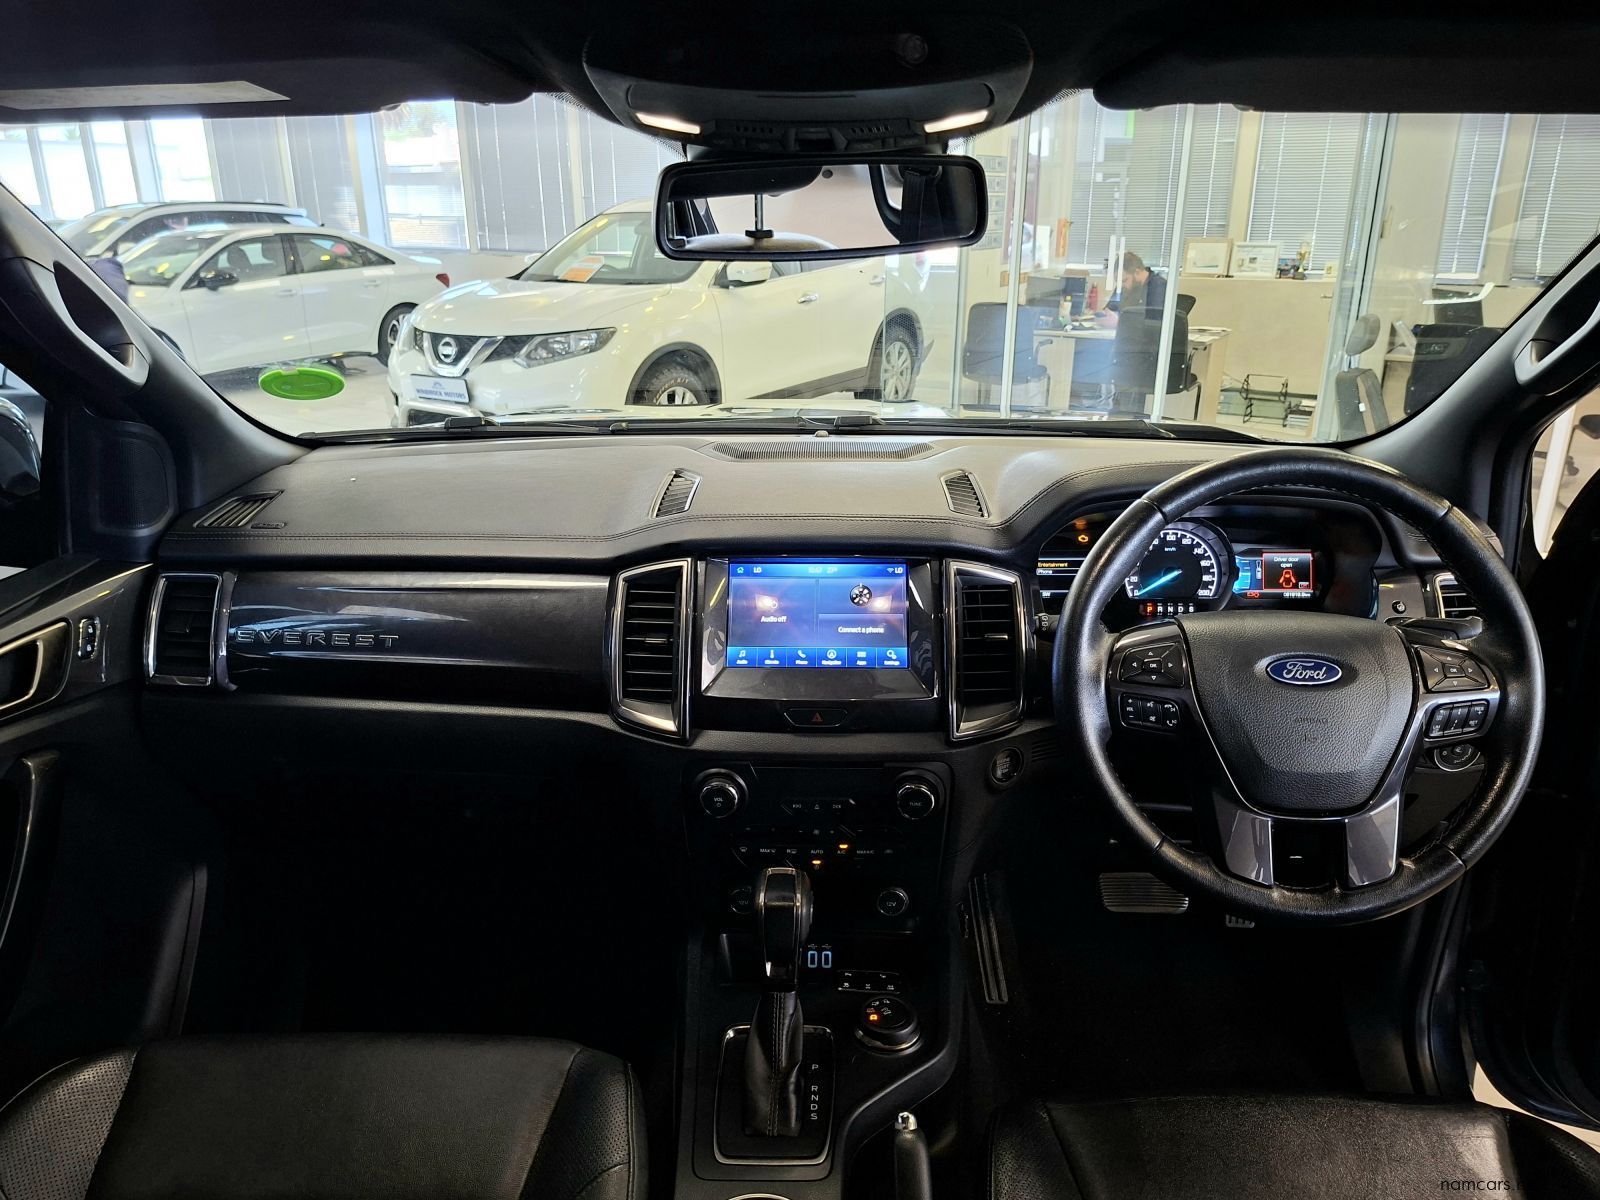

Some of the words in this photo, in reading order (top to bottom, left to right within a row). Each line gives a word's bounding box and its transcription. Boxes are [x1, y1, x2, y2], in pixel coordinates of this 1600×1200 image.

[1194, 547, 1204, 555] 140
[753, 566, 762, 574] LO
[894, 566, 903, 574] LO
[760, 615, 777, 623] Audio
[777, 615, 787, 623] off
[837, 626, 860, 634] Connect
[866, 626, 885, 635] phone
[235, 629, 399, 649] EVEREST
[1282, 661, 1327, 680] Ford
[810, 1103, 818, 1111] D
[810, 1112, 818, 1120] S
